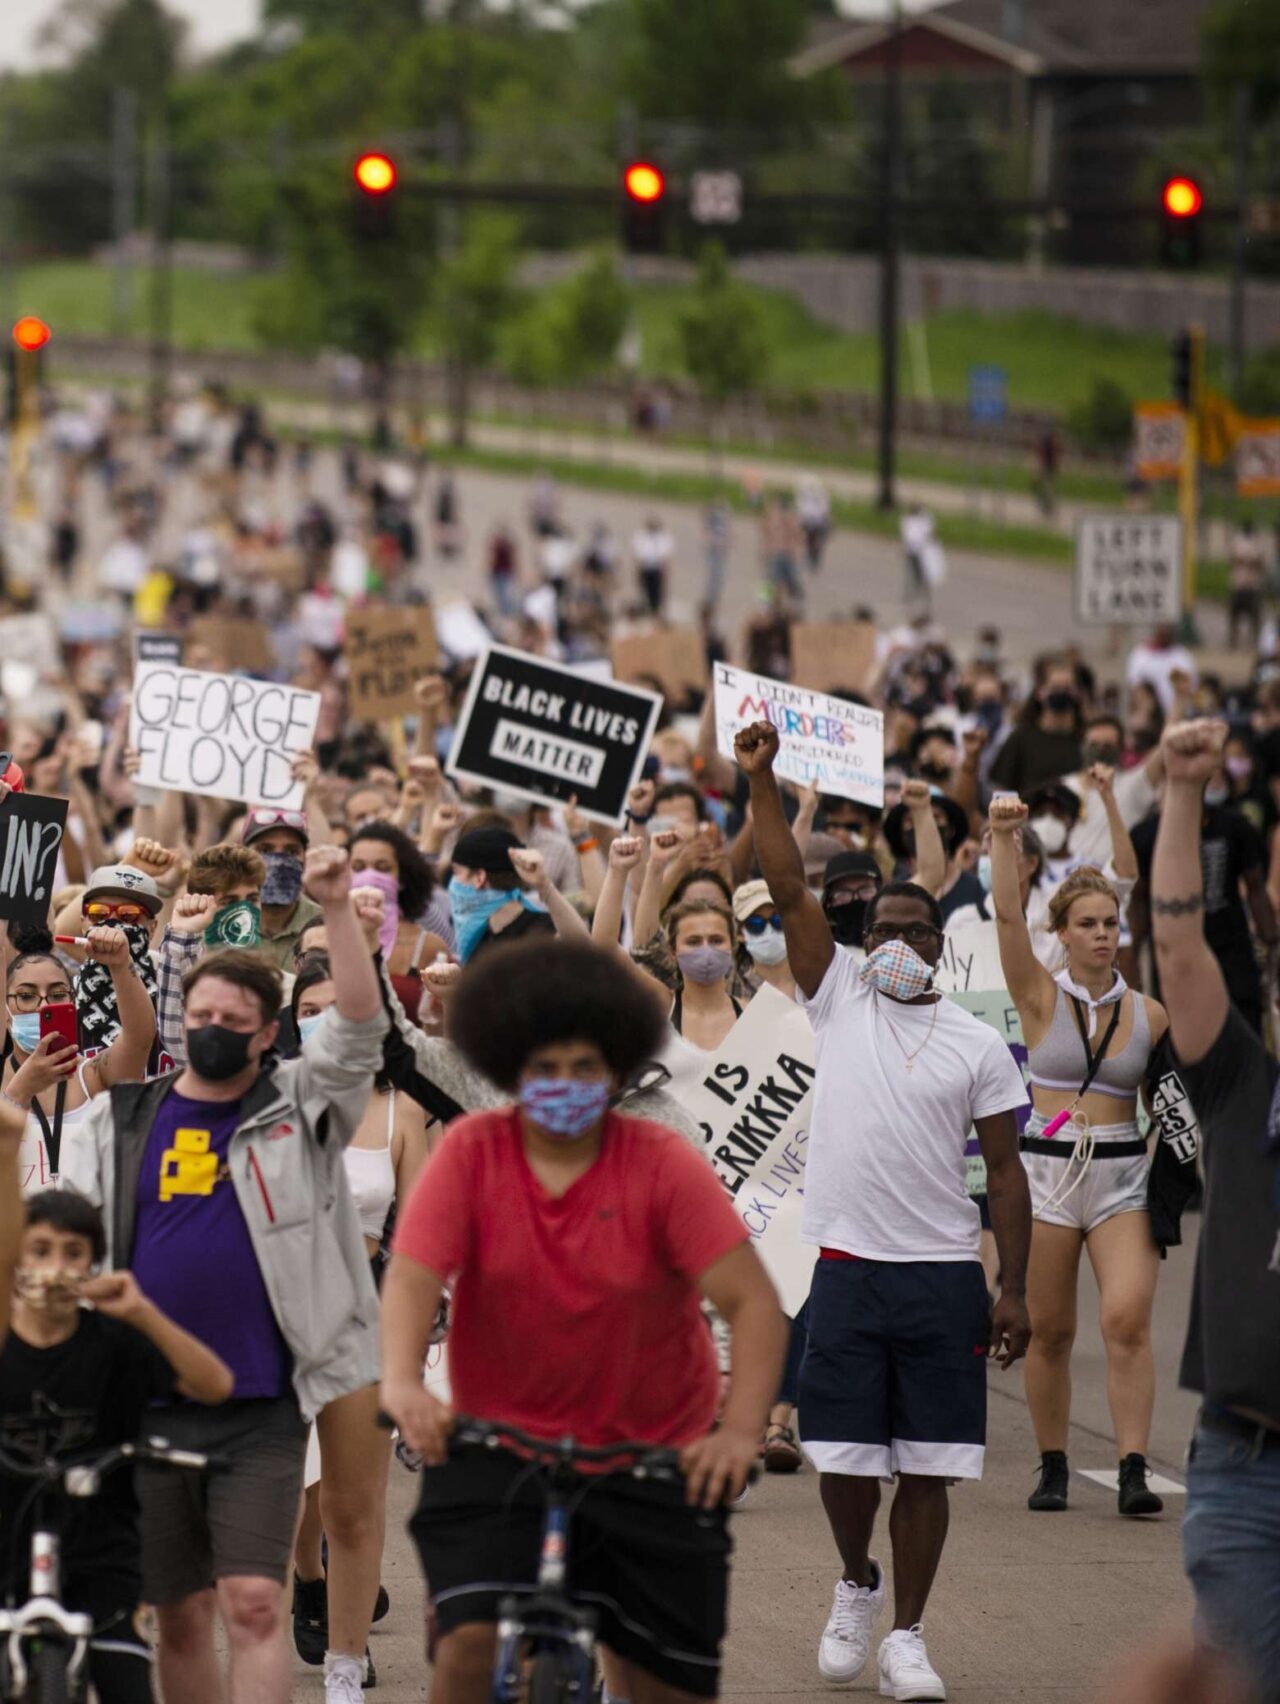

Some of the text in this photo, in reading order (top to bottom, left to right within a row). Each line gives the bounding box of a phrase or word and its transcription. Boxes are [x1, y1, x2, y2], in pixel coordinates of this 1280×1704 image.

[1093, 528, 1163, 549] LEFT
[1092, 558, 1169, 580] TURN
[1088, 589, 1163, 611] LANE
[719, 668, 736, 688] I
[136, 671, 312, 752] GEORGE
[483, 674, 639, 745] BLACK LIVES
[738, 695, 856, 747] MURDERS
[137, 726, 297, 801] FLOYD
[502, 731, 595, 778] MATTER
[703, 1062, 749, 1106] IS
[761, 1129, 809, 1198] LIVES
